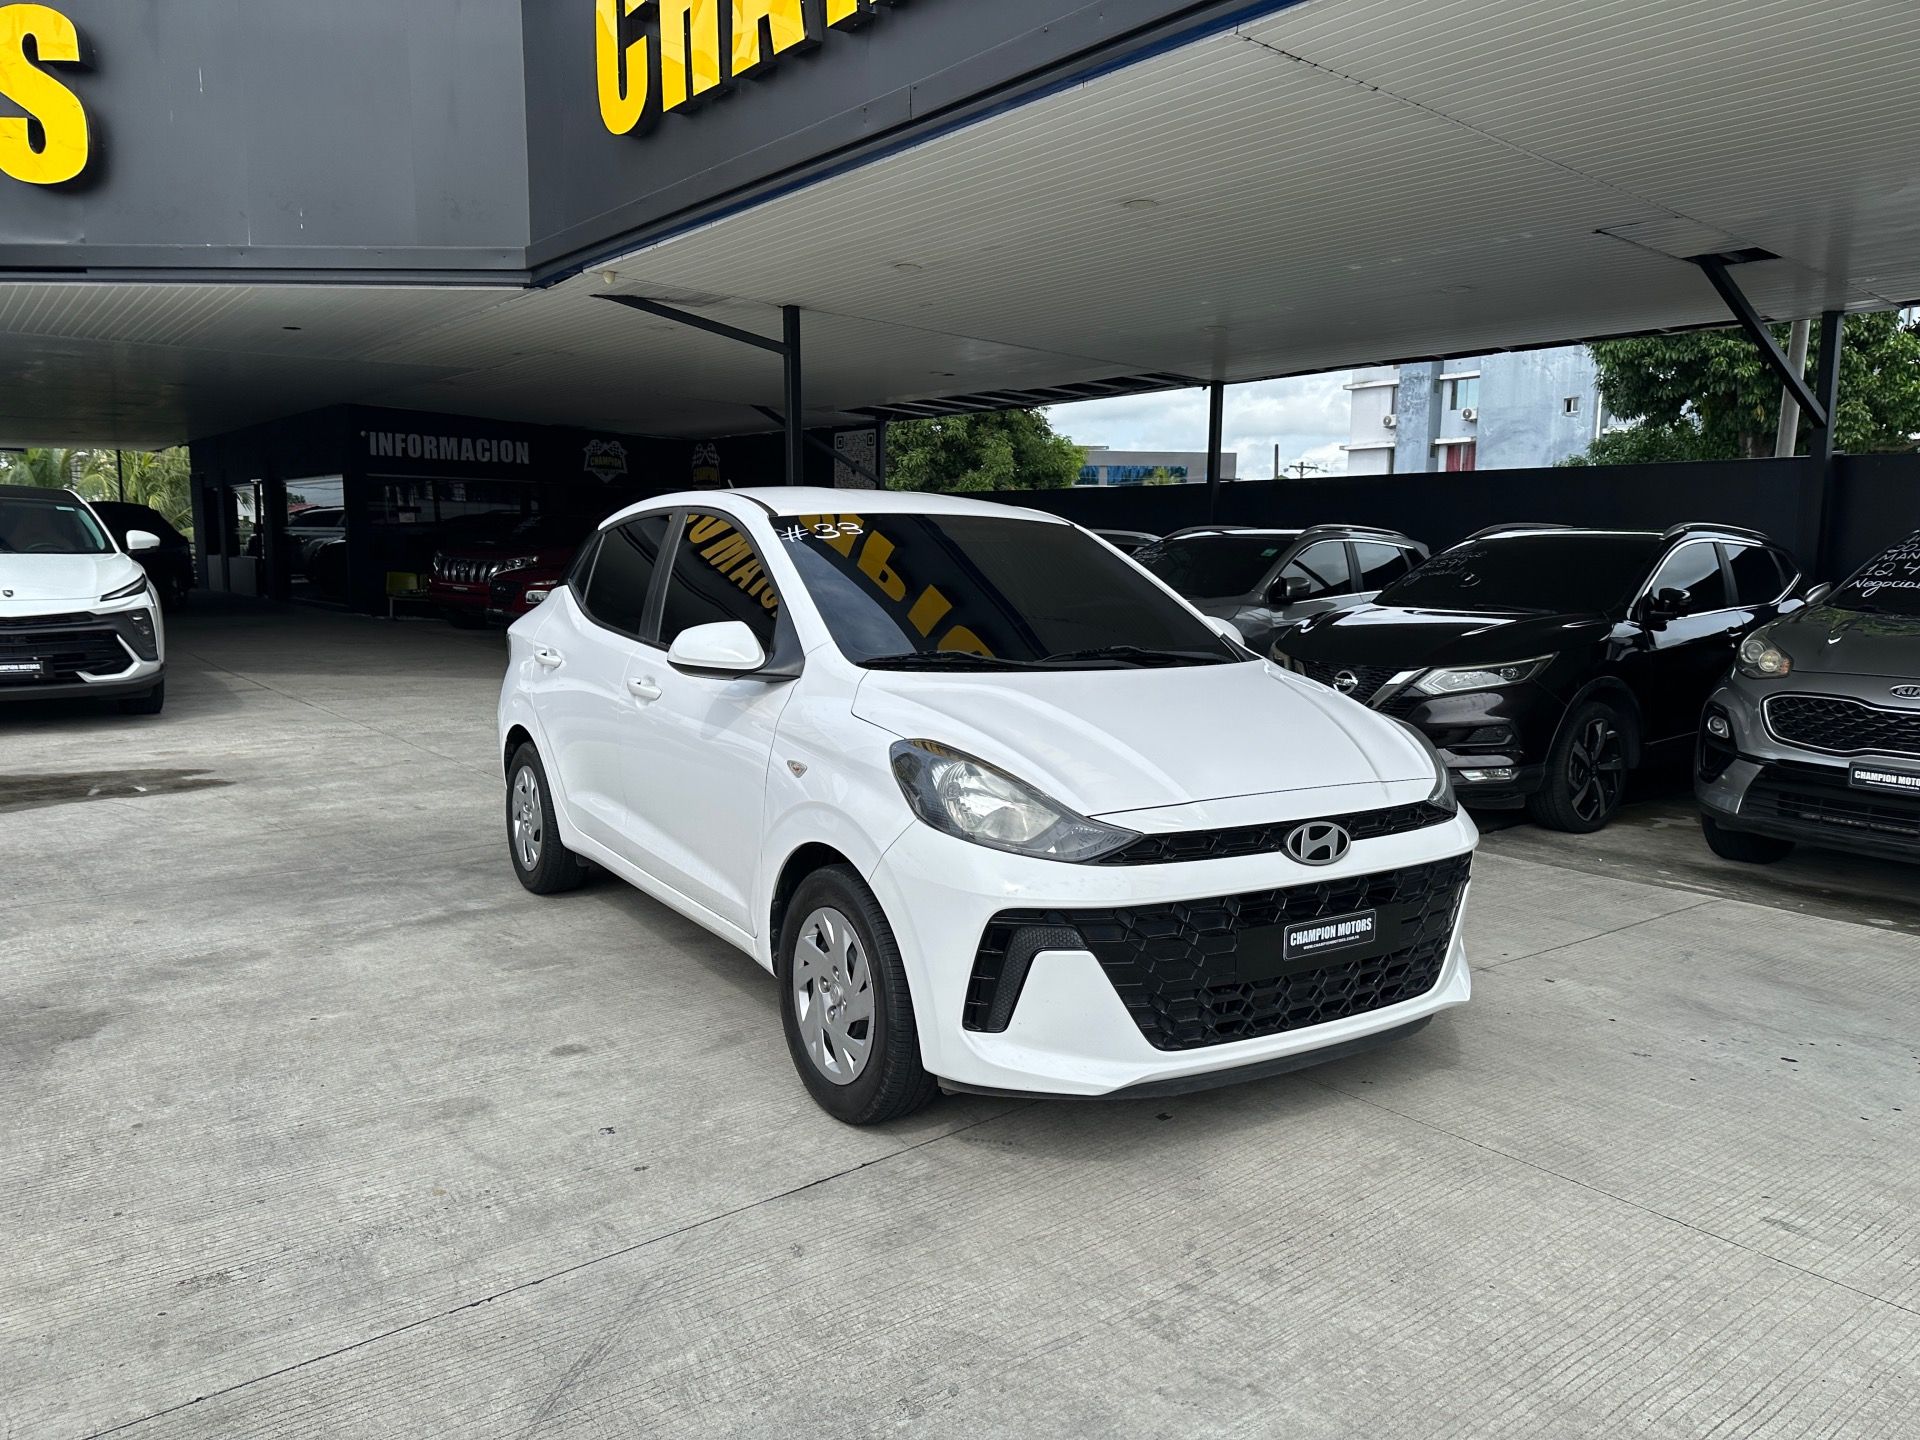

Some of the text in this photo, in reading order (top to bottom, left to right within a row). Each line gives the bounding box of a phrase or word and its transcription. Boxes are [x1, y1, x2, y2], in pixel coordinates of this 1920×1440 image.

[369, 431, 530, 465] INFORMACION
[1854, 770, 1897, 784] CHAMPION
[1290, 917, 1372, 946] CHAMPION MOTORS
